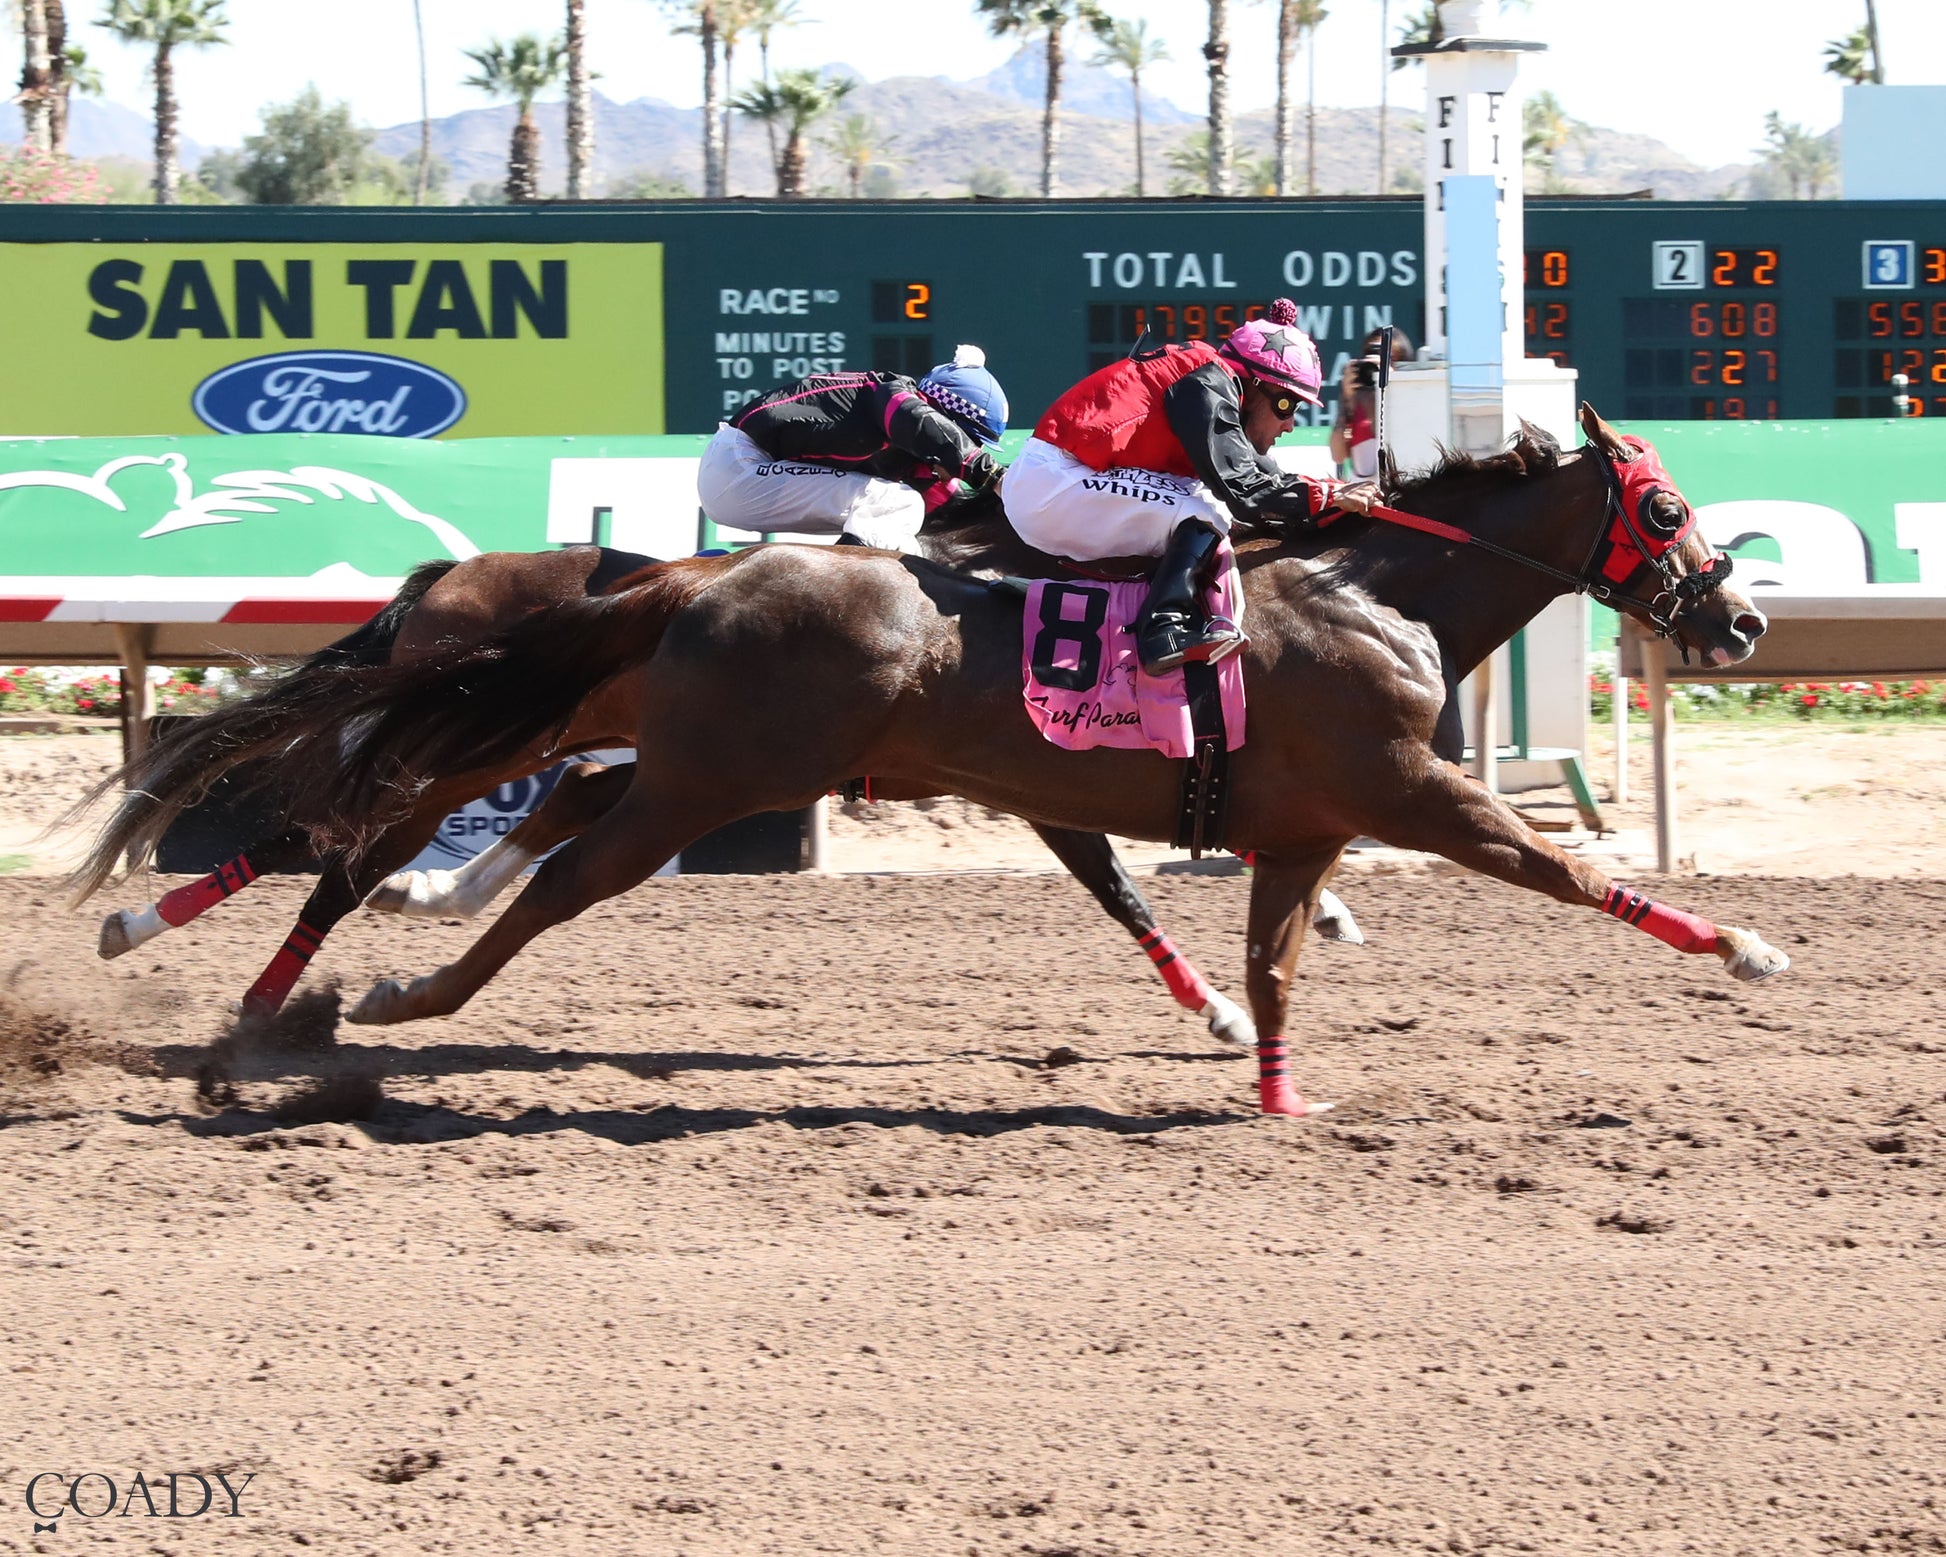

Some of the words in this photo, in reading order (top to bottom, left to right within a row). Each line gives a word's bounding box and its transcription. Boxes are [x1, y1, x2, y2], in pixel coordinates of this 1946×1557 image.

[1083, 252, 1237, 288] TOTAL
[1283, 250, 1417, 287] ODDS
[1670, 249, 1687, 281] 2
[1876, 248, 1900, 282] 3
[88, 258, 313, 341] SAN
[347, 259, 567, 339] TAN
[720, 288, 809, 315] RACE
[905, 284, 930, 319] 2
[1295, 305, 1392, 341] WIN
[1690, 303, 1777, 337] 608
[715, 332, 846, 354] MINUTES
[716, 357, 754, 379] TO
[773, 357, 846, 379] POST
[1691, 350, 1777, 385] 227
[247, 366, 412, 434] Ford
[1032, 583, 1110, 692] 8
